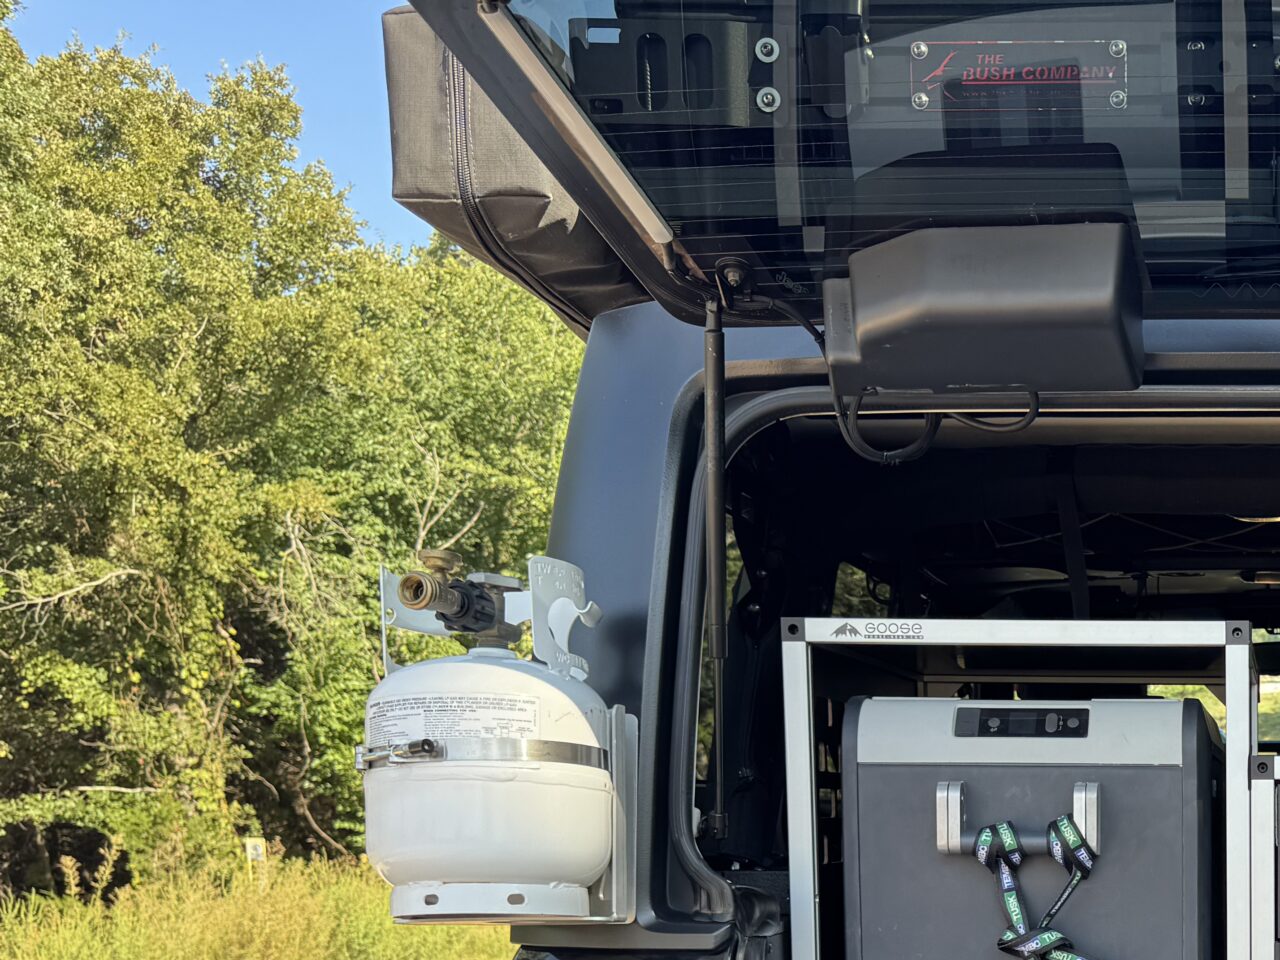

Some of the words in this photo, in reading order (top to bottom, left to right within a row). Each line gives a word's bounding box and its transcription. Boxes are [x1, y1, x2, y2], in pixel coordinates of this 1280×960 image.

[976, 54, 1005, 65] THE
[962, 66, 1016, 81] BUSH
[1021, 65, 1117, 80] COMPANY
[998, 822, 1015, 848] TUSK
[1060, 819, 1077, 844] TUSK
[1007, 895, 1021, 921] TUSK
